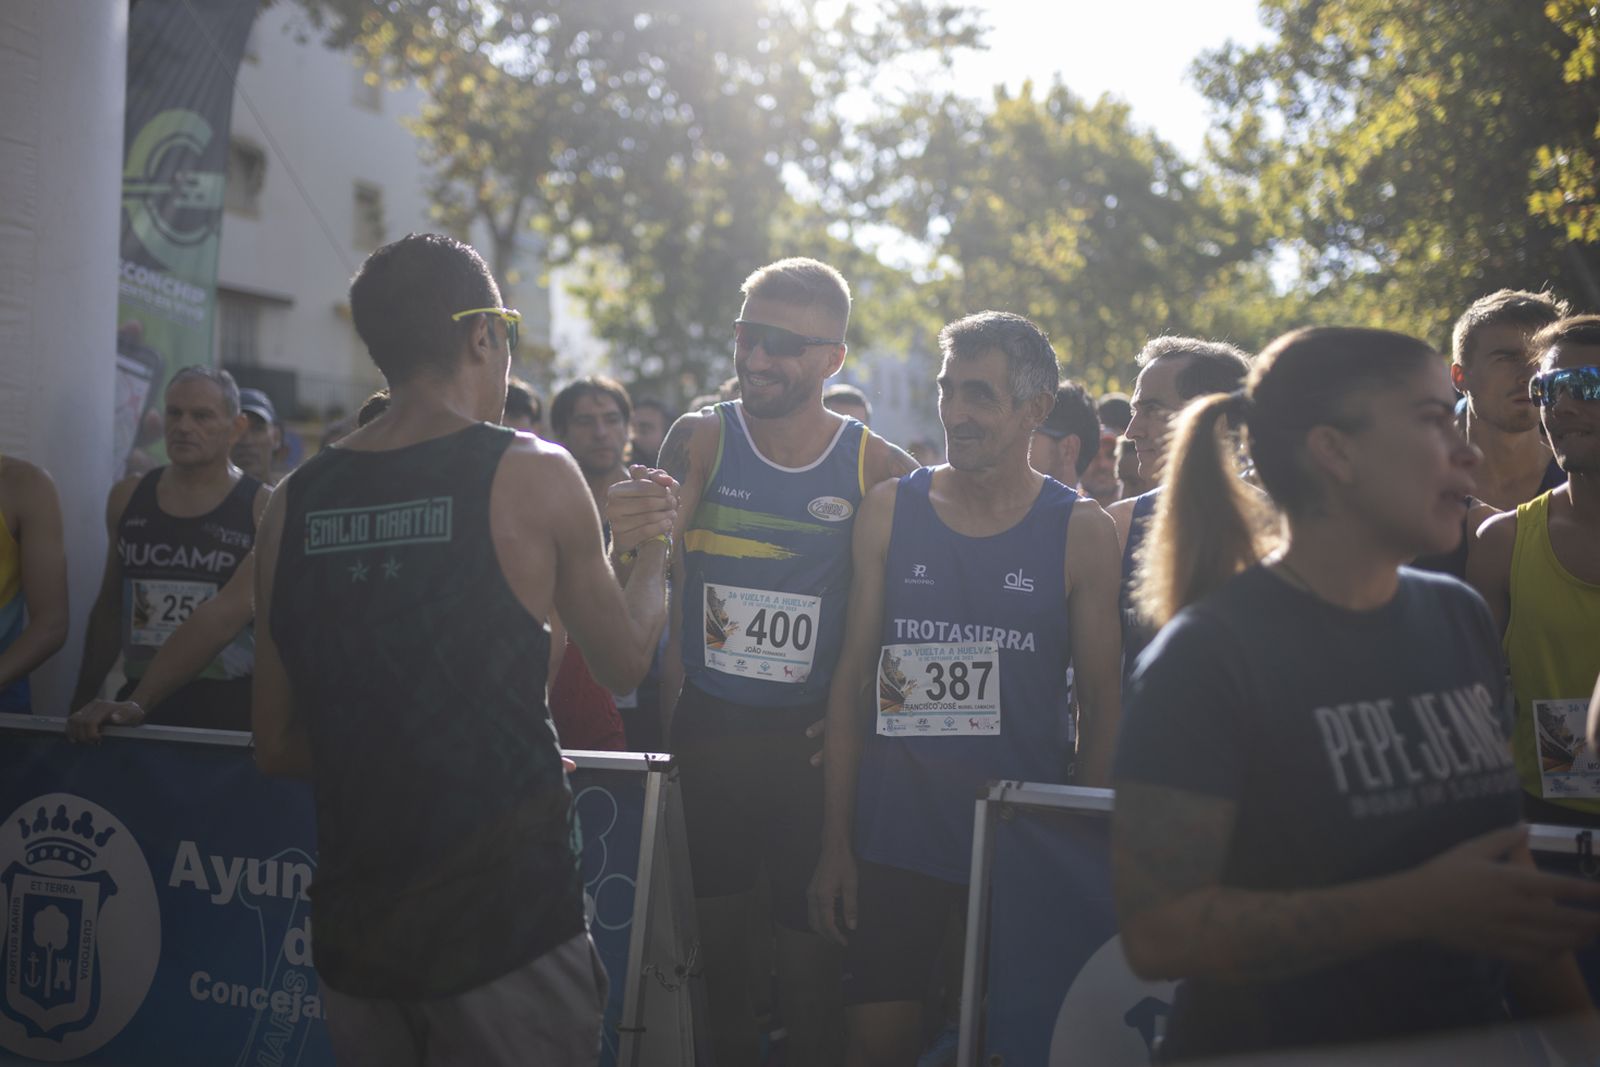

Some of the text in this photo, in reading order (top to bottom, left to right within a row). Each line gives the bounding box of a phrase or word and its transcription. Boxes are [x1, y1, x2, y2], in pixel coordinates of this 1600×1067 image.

[310, 513, 368, 546] EMILIO
[161, 594, 209, 622] 25
[740, 592, 770, 604] VUELTA
[773, 596, 779, 604] A
[783, 597, 814, 608] HUELVA
[745, 608, 812, 651] 400
[894, 618, 1035, 652] TROTASIERRA
[914, 648, 945, 657] VUELTA
[957, 646, 990, 655] HUELVA
[925, 661, 993, 701] 387
[1313, 698, 1424, 793] PEPE
[30, 880, 76, 895] ET TERRA
[80, 919, 93, 981] CUSTODIA
[189, 970, 327, 1023] Conceja
